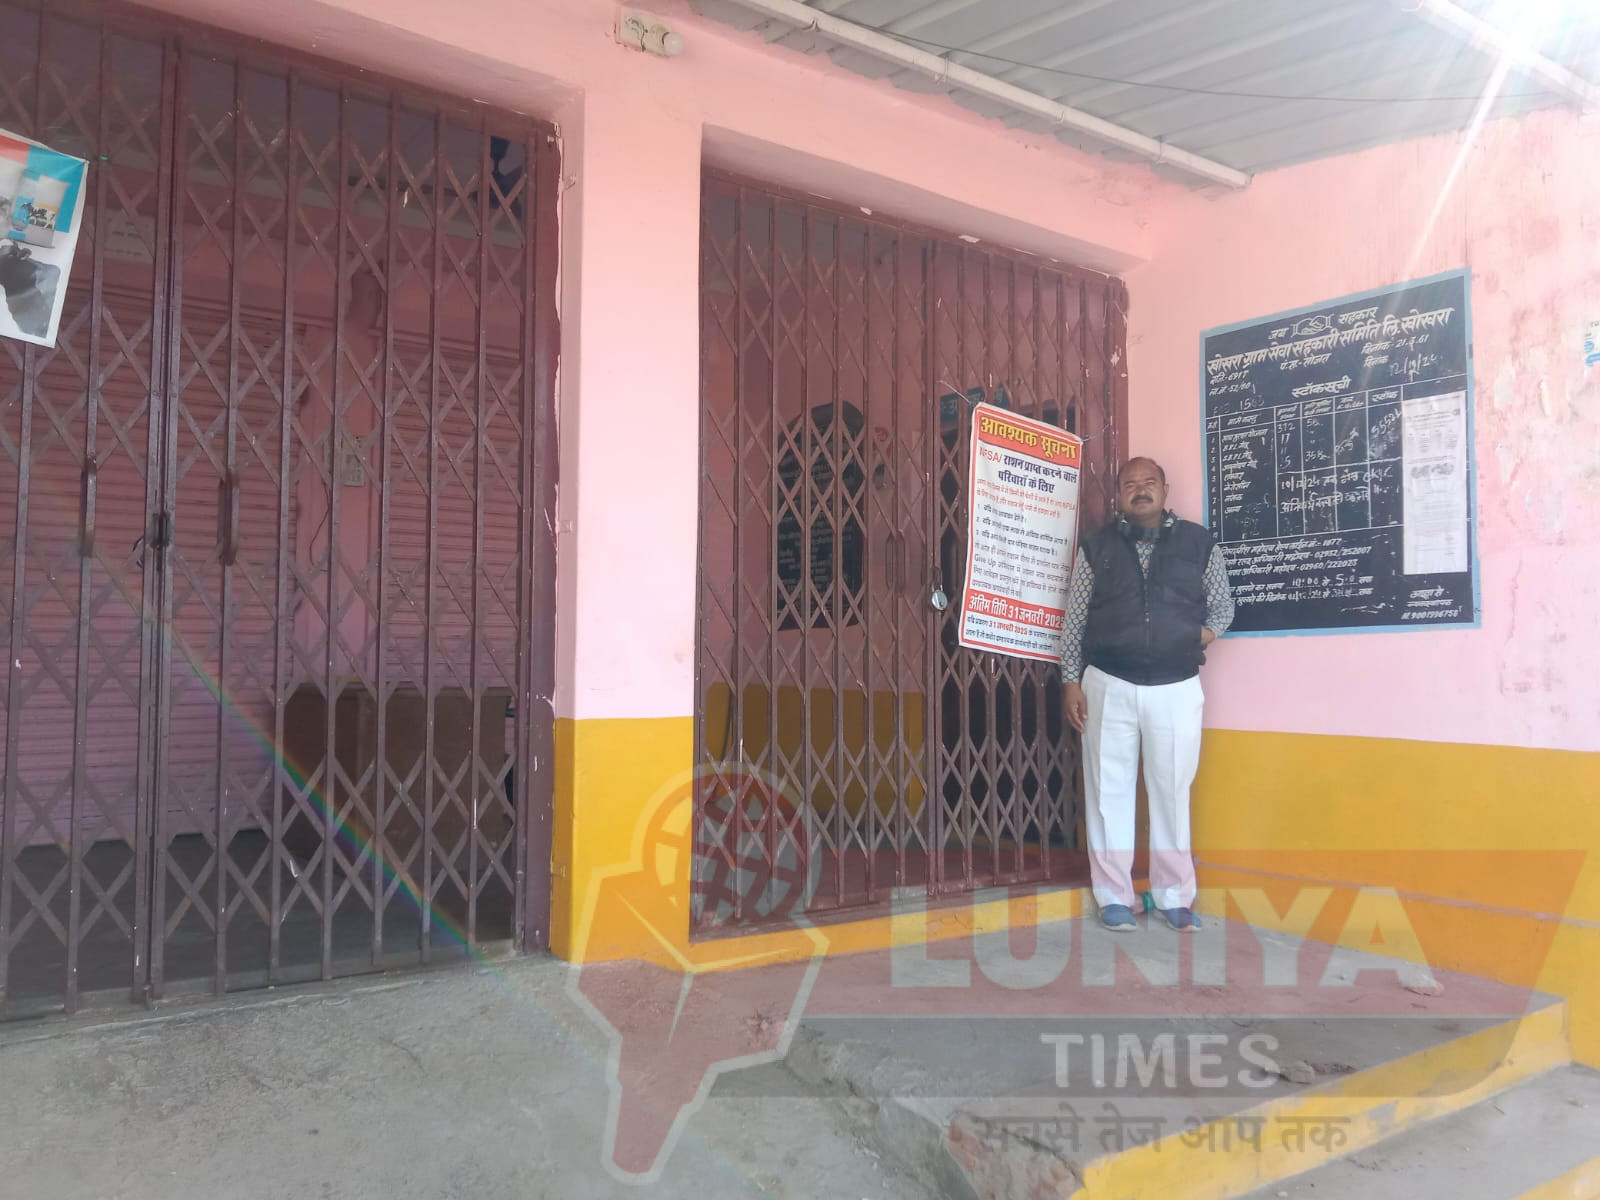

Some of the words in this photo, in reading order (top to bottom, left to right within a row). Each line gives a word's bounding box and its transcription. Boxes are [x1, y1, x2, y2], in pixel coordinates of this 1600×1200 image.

[1338, 307, 1379, 324] सहकार
[1207, 354, 1243, 375] खोखरा
[1243, 349, 1269, 368] ग्राम
[1268, 341, 1292, 360] सेवा
[1292, 328, 1340, 356] सहकारी
[1340, 319, 1381, 347] समिति
[1401, 307, 1455, 334] खोखरा
[1303, 353, 1331, 367] सोजत
[981, 416, 1038, 446] आवश्यक
[1040, 434, 1077, 458] सूचना
[1004, 454, 1024, 468] राशन
[1024, 461, 1041, 475] प्राप्त
[1042, 465, 1061, 479] करने
[1063, 471, 1077, 483] वाले
[1038, 480, 1055, 493] लिए
[974, 553, 986, 563] Give
[987, 557, 996, 568] Up
[969, 593, 989, 612] अंतिम
[991, 597, 1008, 616] तिथि
[1019, 607, 1044, 625] जनवरी
